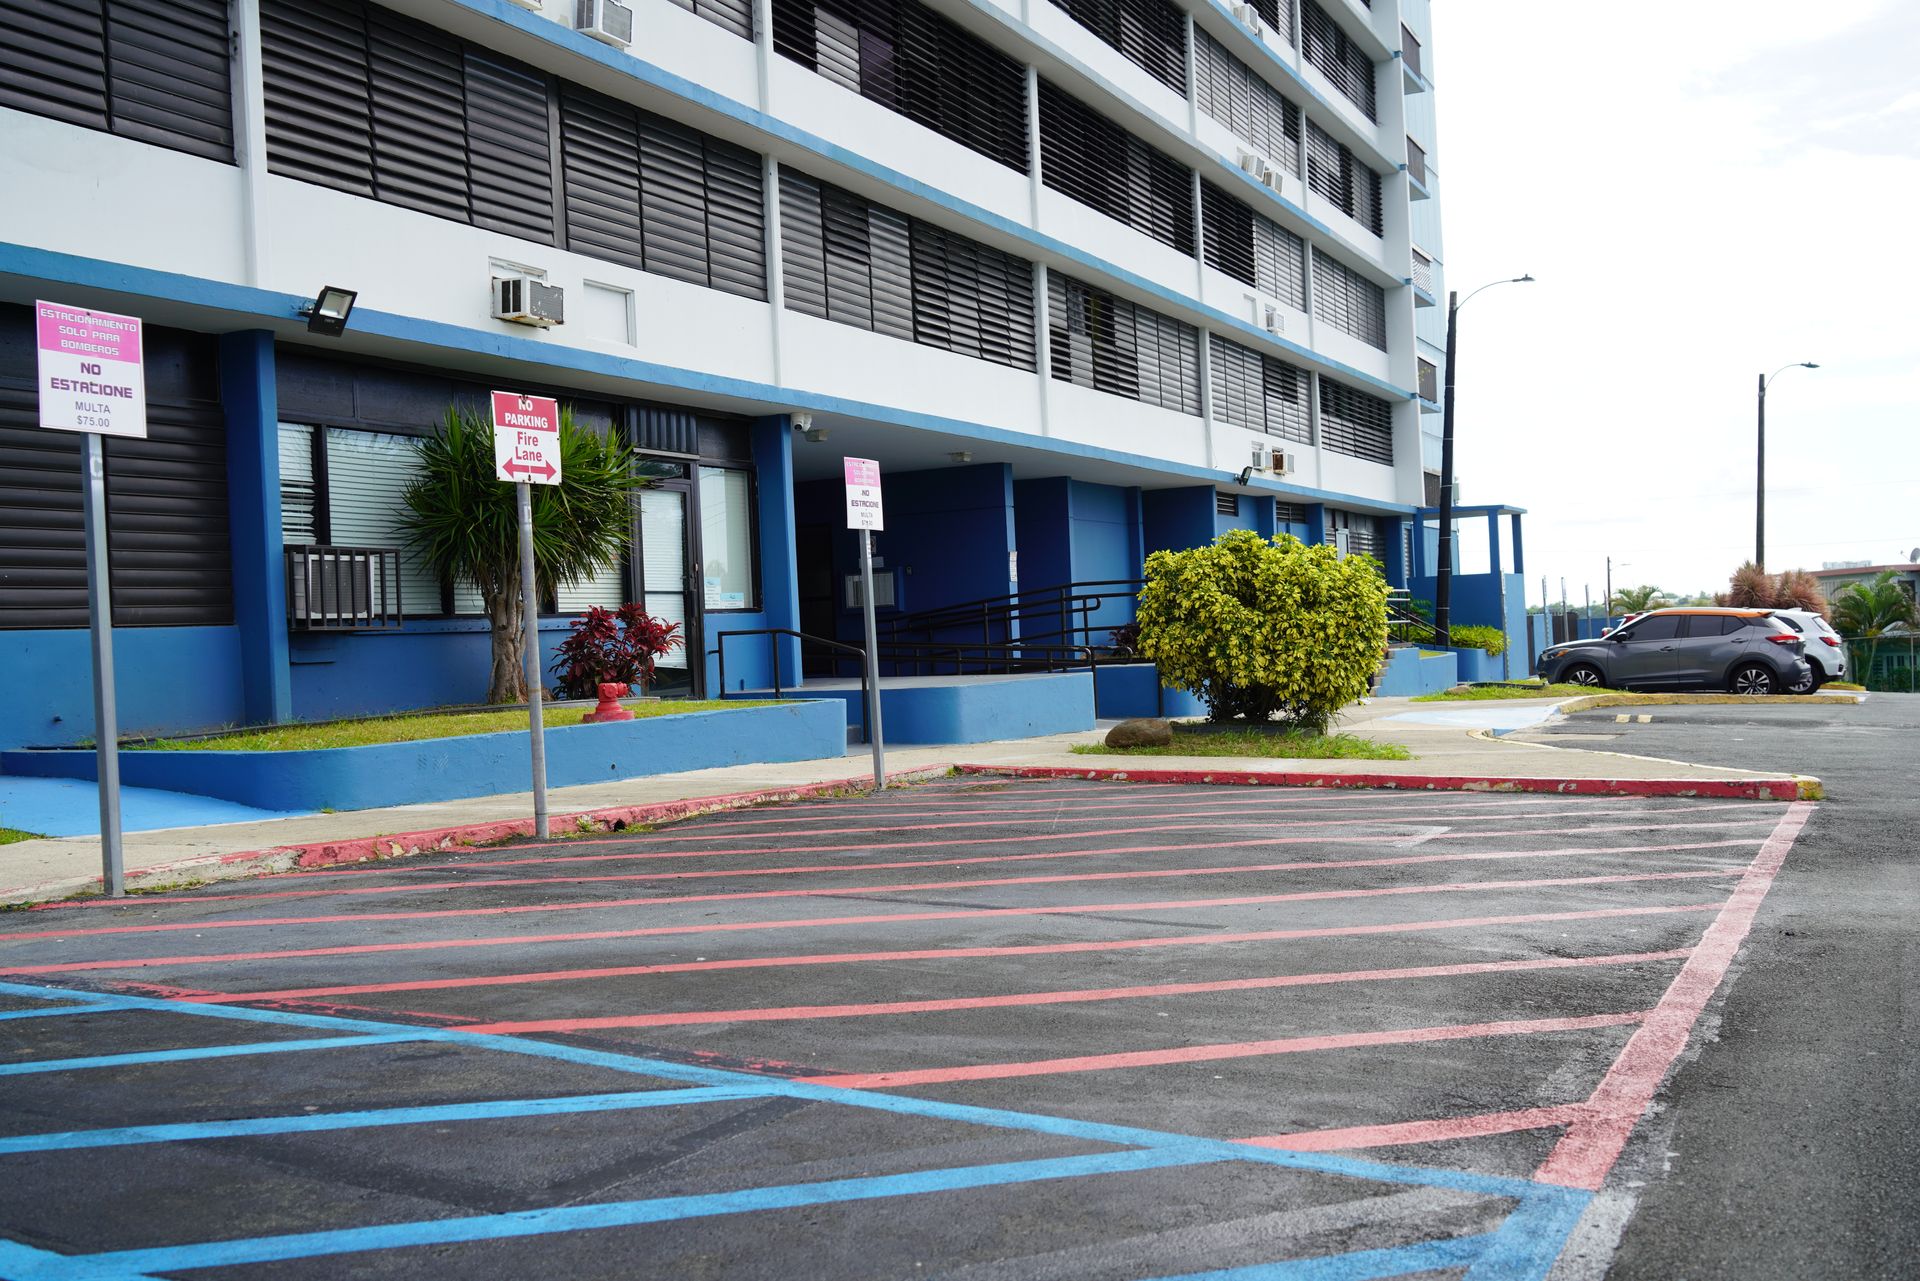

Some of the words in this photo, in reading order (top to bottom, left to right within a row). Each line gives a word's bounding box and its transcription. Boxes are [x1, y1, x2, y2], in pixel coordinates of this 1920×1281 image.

[40, 308, 137, 332] ESTACIONAMIENTO
[59, 325, 87, 338] SOLO
[92, 330, 120, 343] PARA
[61, 339, 119, 356] BOMBEROS
[80, 362, 101, 376] NO
[50, 377, 133, 399] ESTACIONE
[75, 401, 111, 414] MULTA
[518, 398, 533, 411] NO
[76, 415, 110, 427] $75.00
[504, 412, 548, 428] PARKING
[517, 431, 538, 447] Fire
[515, 446, 542, 462] Lane
